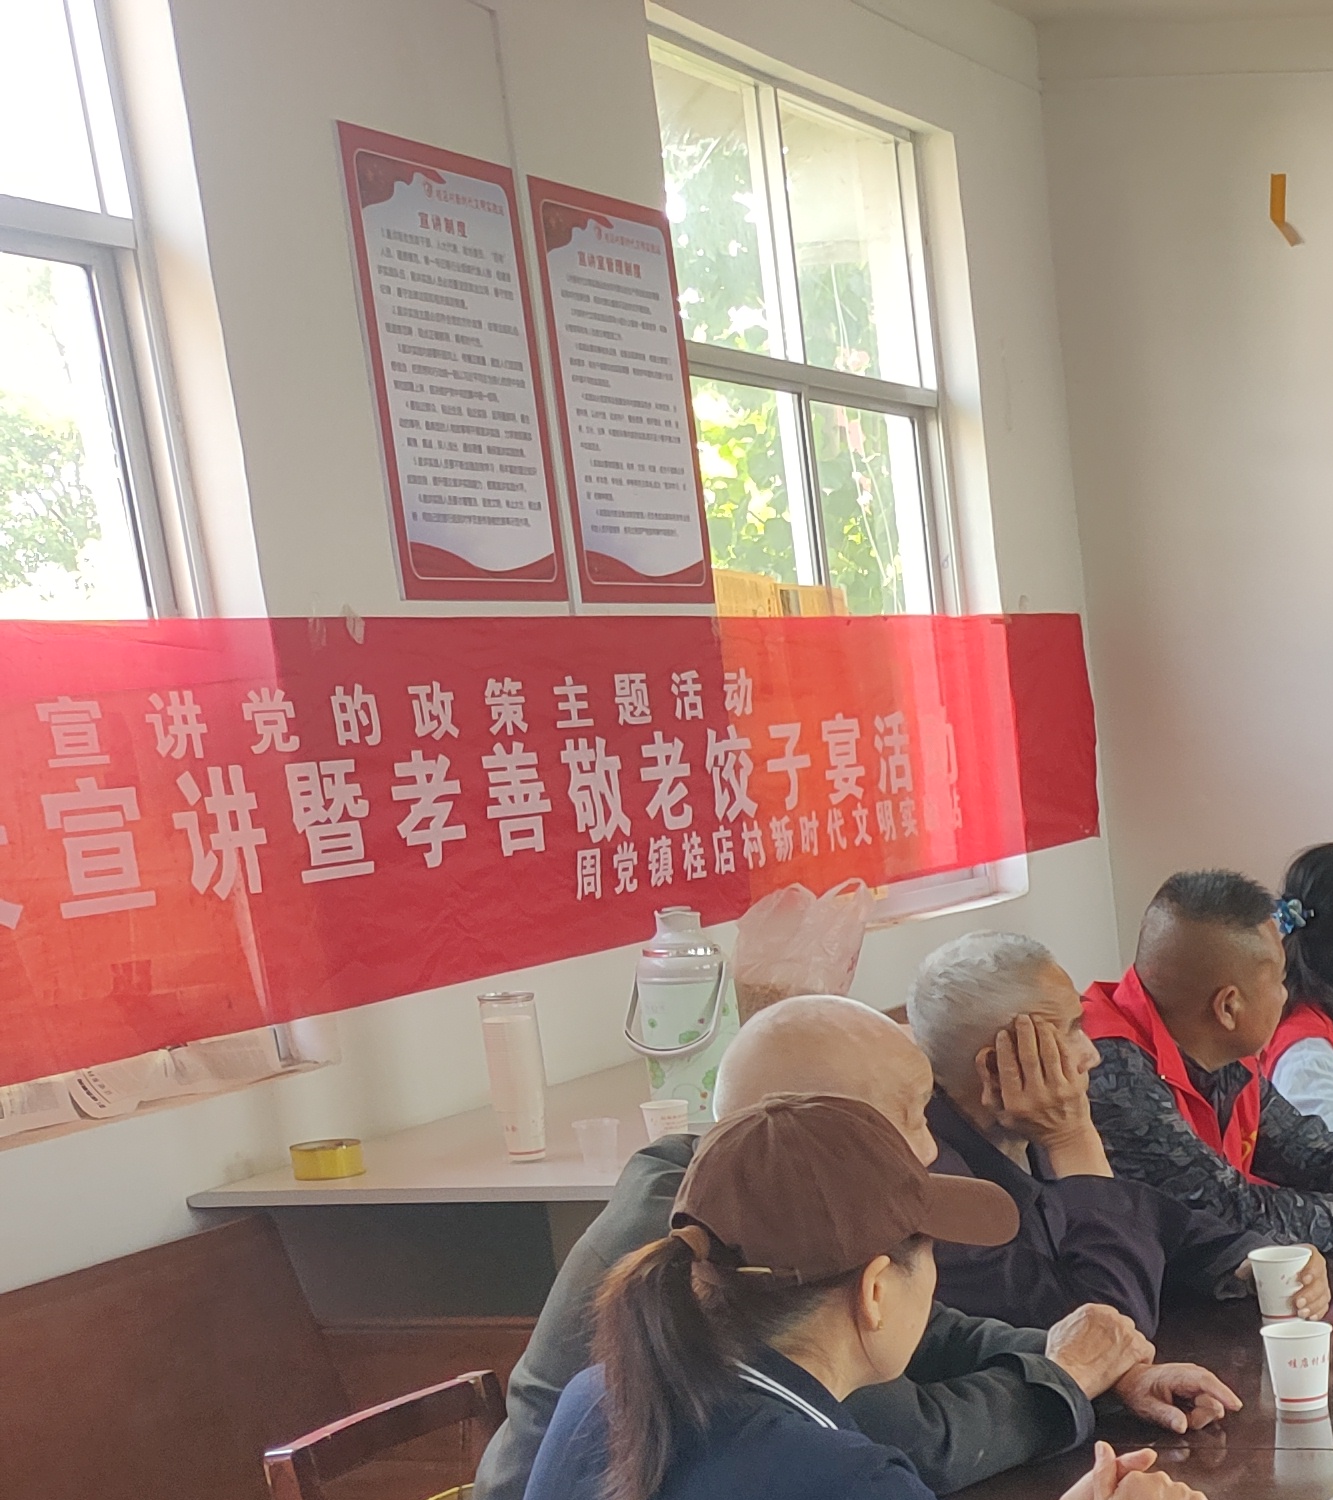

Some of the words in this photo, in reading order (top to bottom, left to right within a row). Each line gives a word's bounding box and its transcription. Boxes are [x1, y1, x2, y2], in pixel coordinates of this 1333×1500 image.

[35, 667, 753, 768] 宣讲党的政策主题活动
[0, 710, 959, 931] 宣讲暨孝善敬老饺子宴活
[576, 786, 963, 901] 周党镇桂店村新时代文明实
